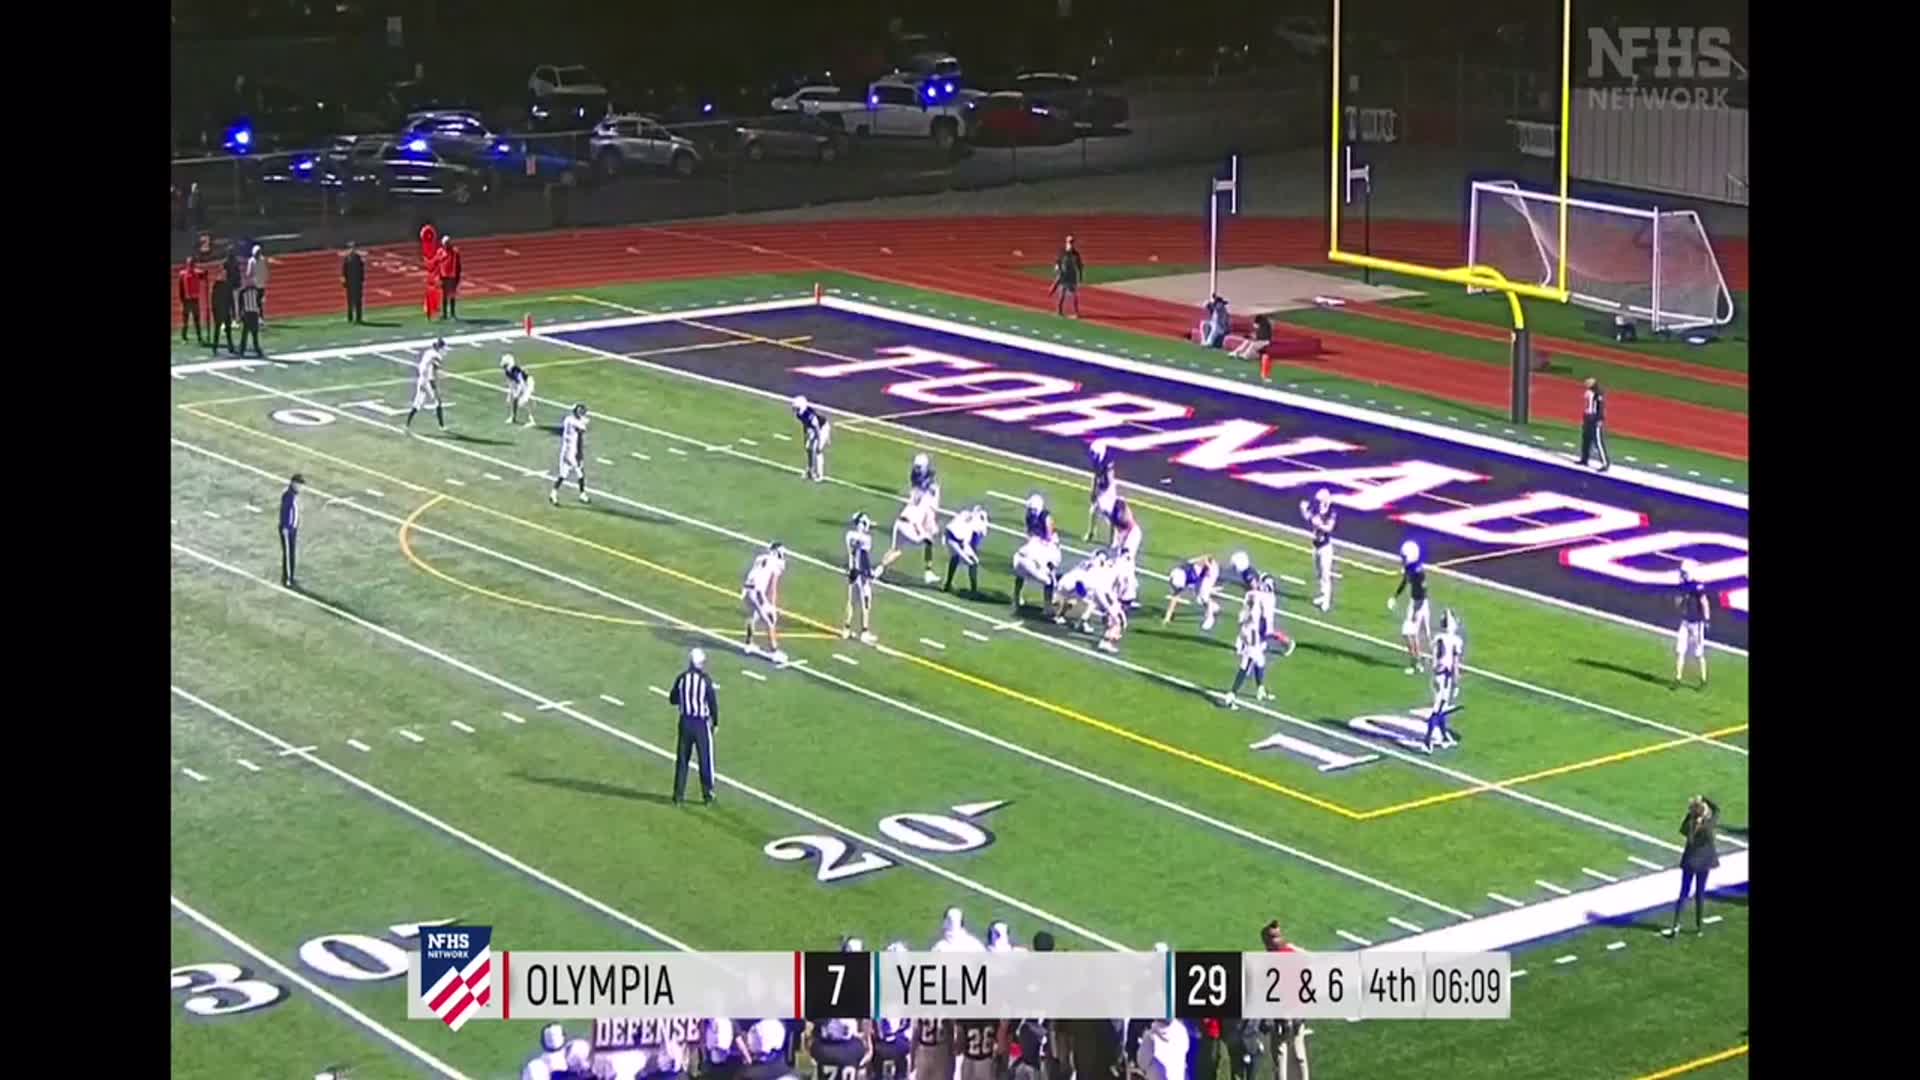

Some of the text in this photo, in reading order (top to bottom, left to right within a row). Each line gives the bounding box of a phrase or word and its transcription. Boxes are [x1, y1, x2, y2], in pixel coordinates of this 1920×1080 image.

[796, 345, 1749, 612] TORNADO
[763, 812, 996, 883] 20
[171, 933, 409, 1016] 30
[595, 1017, 701, 1047] DEFENSE
